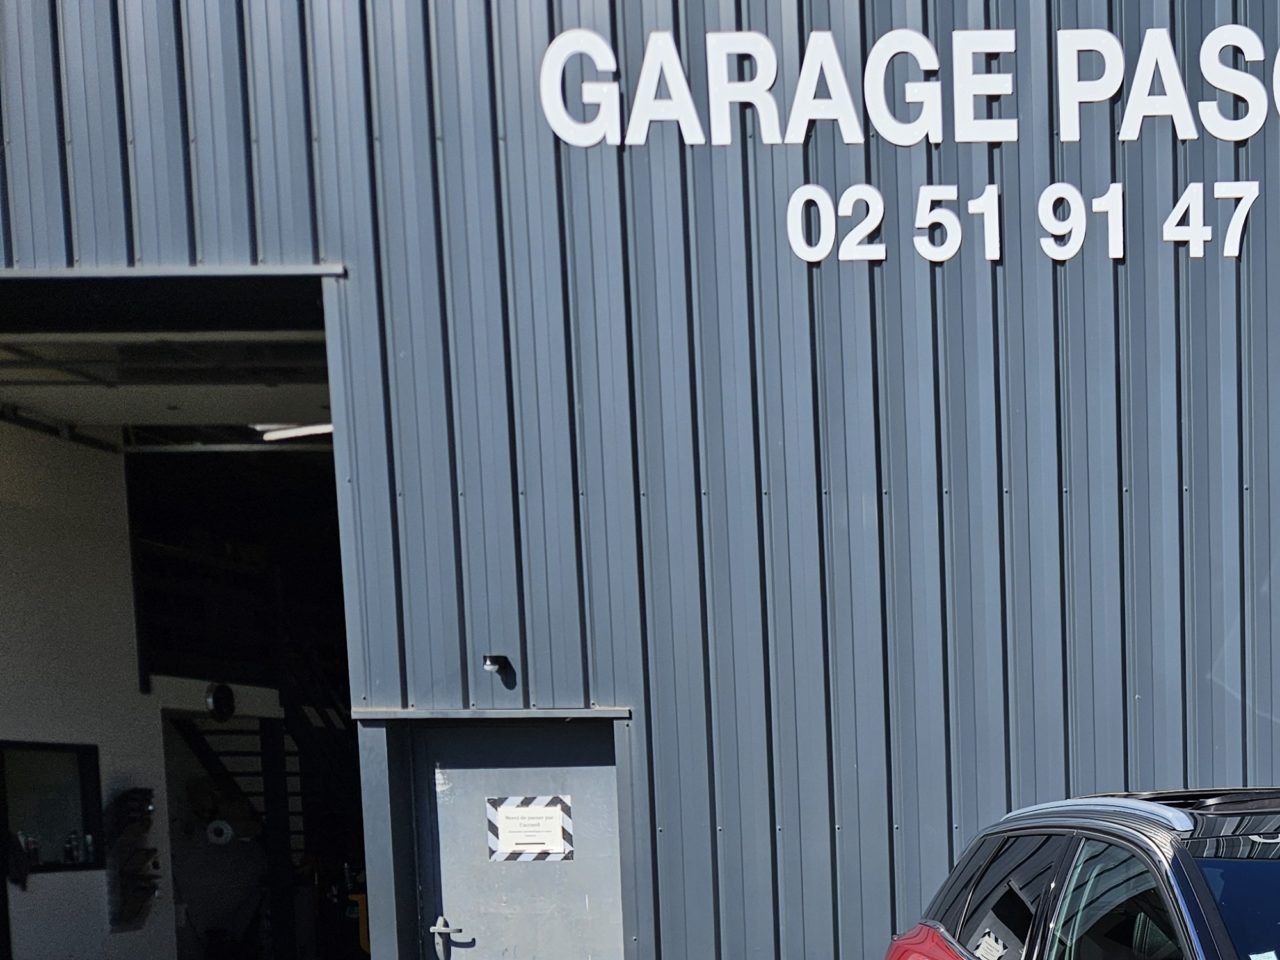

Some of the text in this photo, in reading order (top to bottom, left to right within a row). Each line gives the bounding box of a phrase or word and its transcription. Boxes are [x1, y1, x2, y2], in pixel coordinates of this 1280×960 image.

[540, 28, 1018, 147] GARAGE
[787, 184, 886, 262] 02
[913, 184, 1000, 262] 51
[1038, 182, 1124, 261] 91
[1162, 181, 1259, 258] 47
